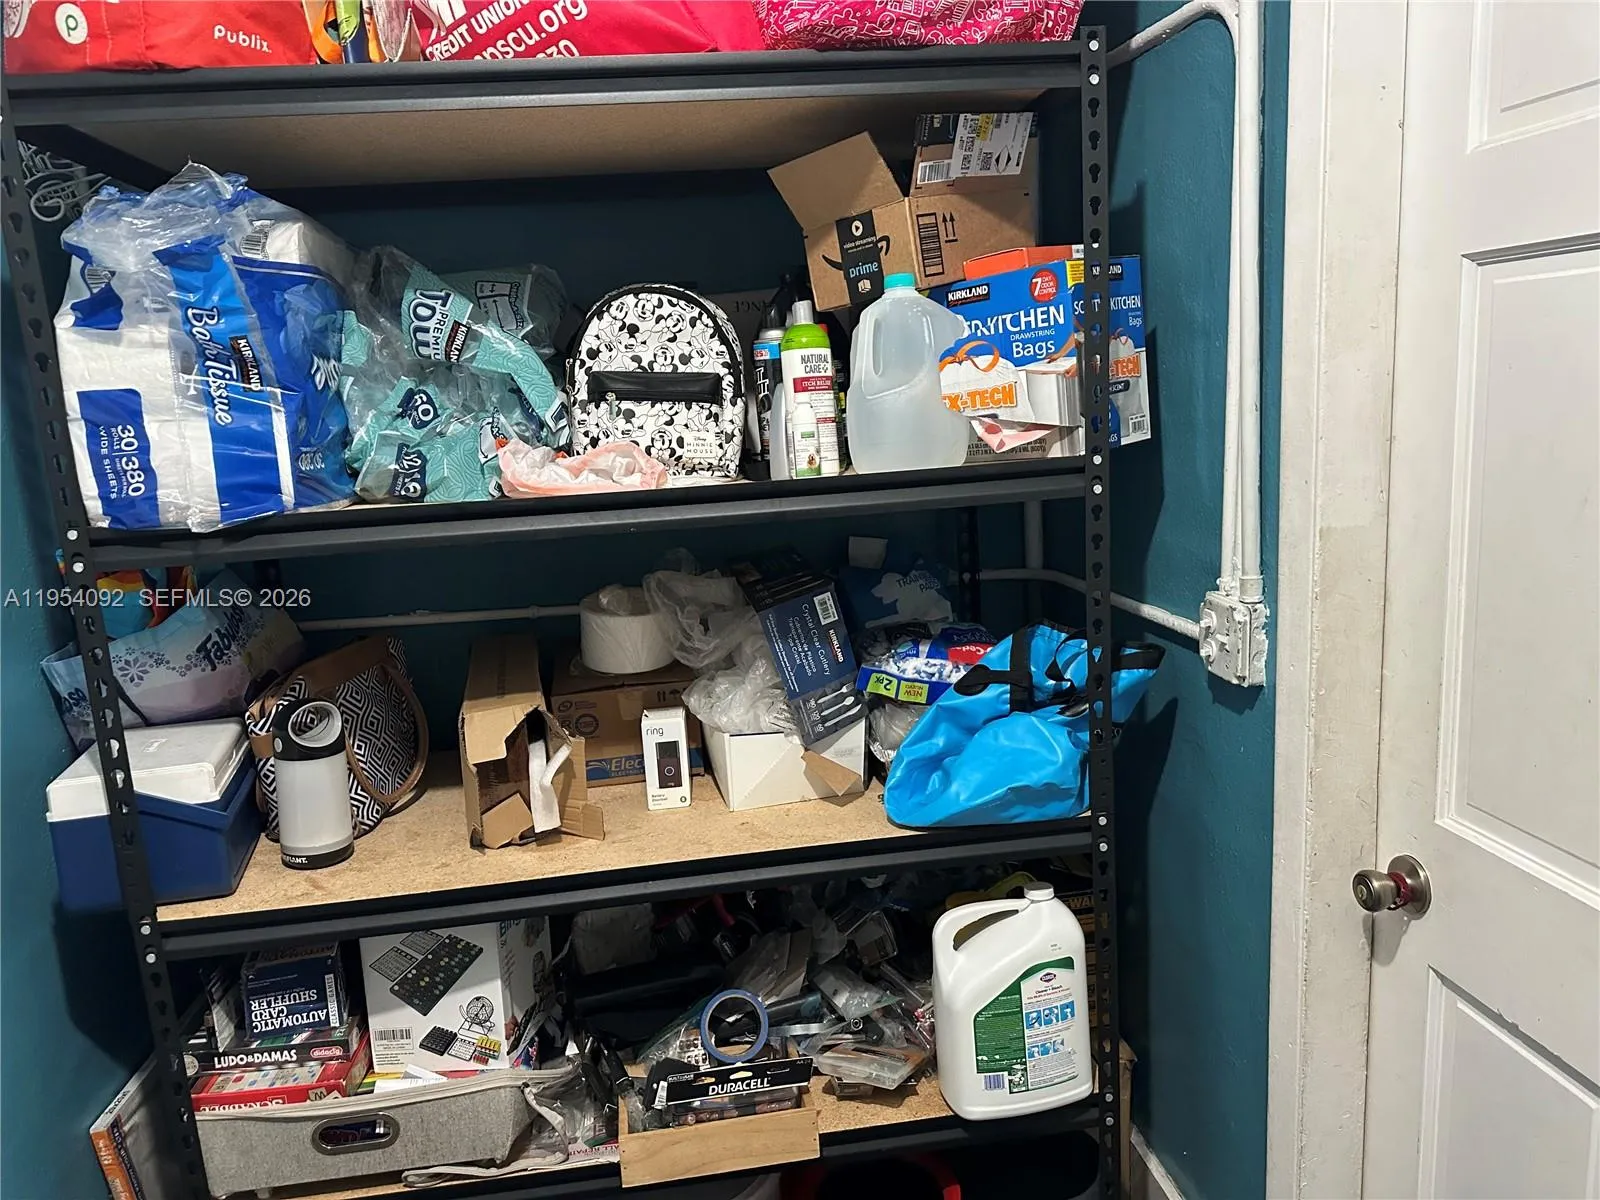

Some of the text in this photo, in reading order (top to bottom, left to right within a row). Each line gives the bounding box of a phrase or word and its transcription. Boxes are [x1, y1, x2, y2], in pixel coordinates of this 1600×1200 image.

[425, 24, 473, 61] CREDIT
[849, 262, 879, 278] prime
[948, 285, 988, 301] KIRKLAND
[1032, 277, 1042, 296] 7
[1110, 295, 1141, 310] KITCHEN
[1128, 316, 1143, 328] Bags
[432, 311, 450, 361] PREMIU
[450, 324, 469, 363] KIRKLAN
[1010, 329, 1055, 341] DRAWSTRING
[1012, 340, 1055, 358] Bags
[237, 339, 262, 391] KIRKLAND
[801, 354, 829, 364] NATURAL
[110, 427, 120, 450] ROLLS
[99, 425, 118, 500] WIDE SHEETS
[117, 425, 146, 497] 30 380
[802, 603, 831, 675] Crystal Clear Cutlery
[829, 629, 844, 663] KIRKLAND
[792, 646, 802, 665] Cristal
[800, 652, 812, 676] Acabado
[903, 689, 923, 698] NEW
[646, 727, 664, 737] ring
[250, 990, 317, 1011] SHUFFLER
[326, 976, 338, 1026] CLASSIC GAMES
[252, 1006, 287, 1021] CARD
[253, 1009, 327, 1033] AUTOMATIC
[214, 1050, 297, 1068] LUDO&DAMAS
[708, 1078, 770, 1096] DURACELL
